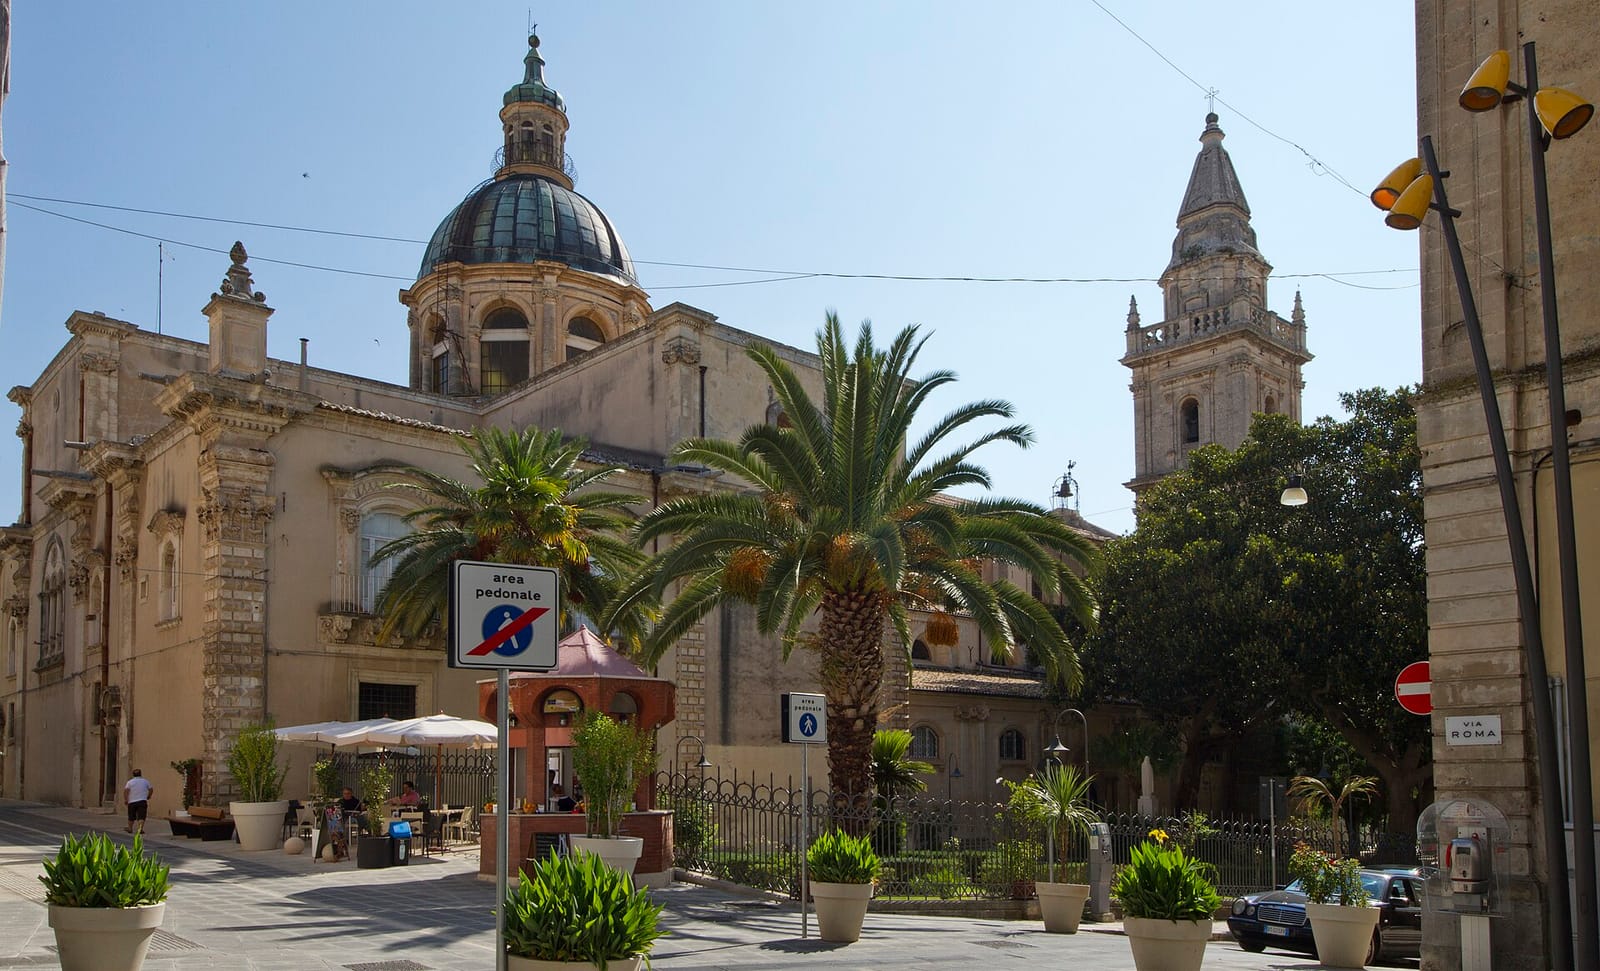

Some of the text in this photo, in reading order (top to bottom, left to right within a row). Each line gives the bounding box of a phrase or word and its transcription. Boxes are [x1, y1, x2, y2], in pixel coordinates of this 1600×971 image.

[493, 574, 524, 584] area
[476, 588, 541, 601] pedonale
[1452, 730, 1496, 738] ROMA
